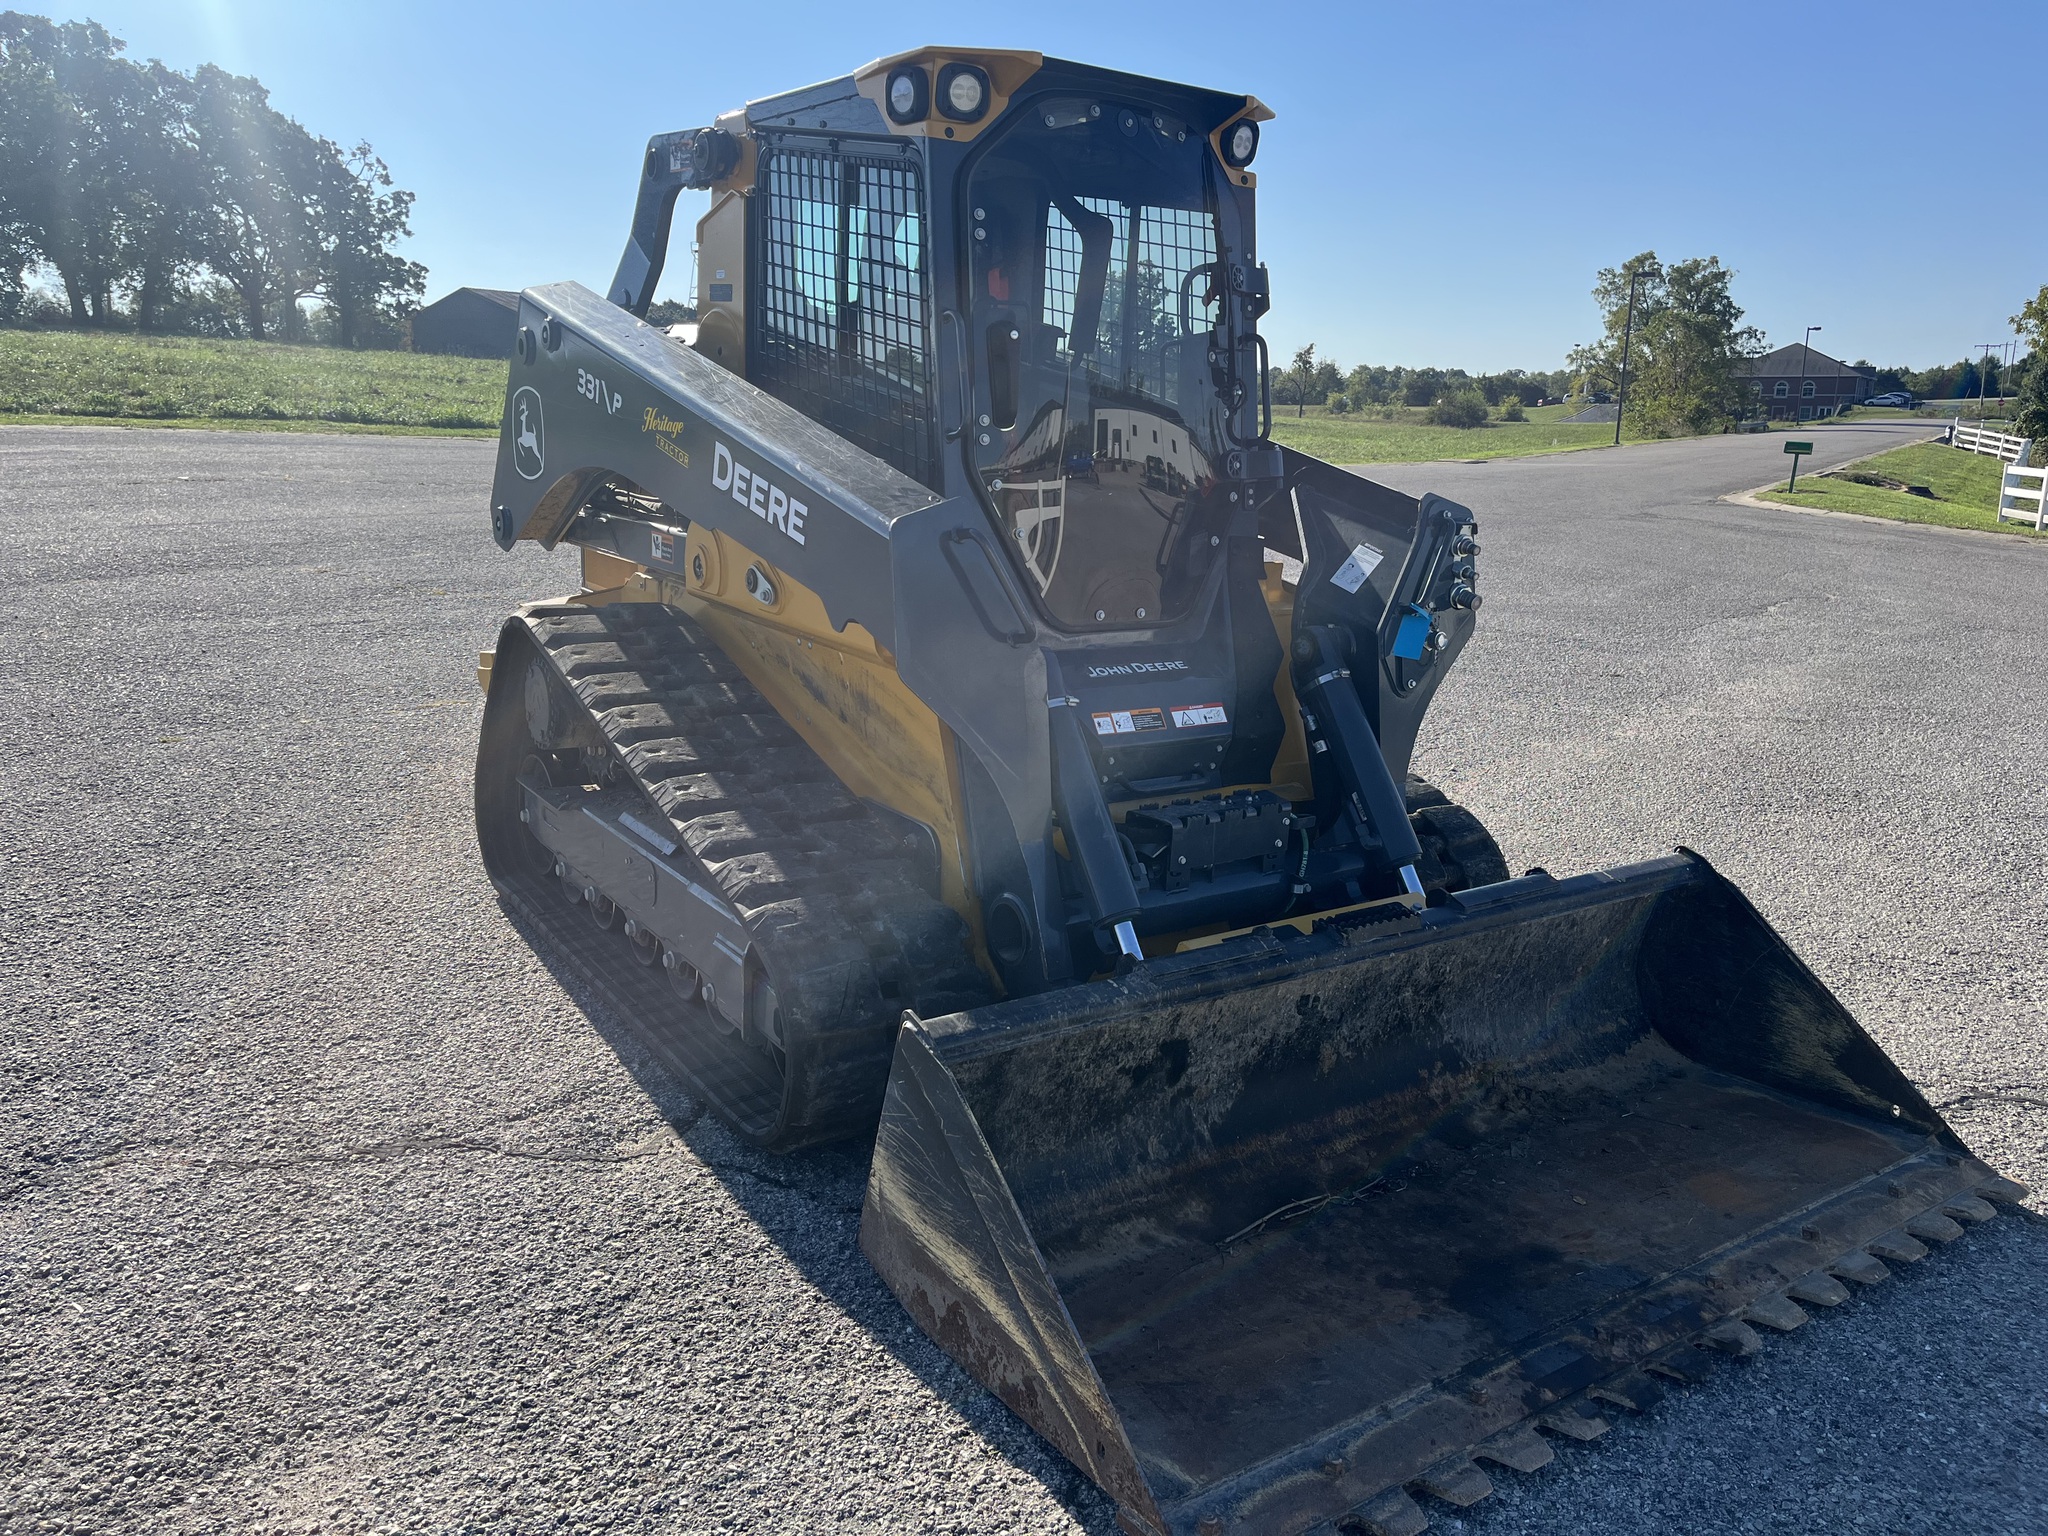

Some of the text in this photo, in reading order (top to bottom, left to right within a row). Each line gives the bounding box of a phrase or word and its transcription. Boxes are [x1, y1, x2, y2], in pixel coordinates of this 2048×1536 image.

[642, 407, 684, 438] Heritage
[655, 435, 689, 466] TRACTOR
[712, 440, 808, 546] DEERE
[1088, 661, 1188, 677] JOHN DEERE
